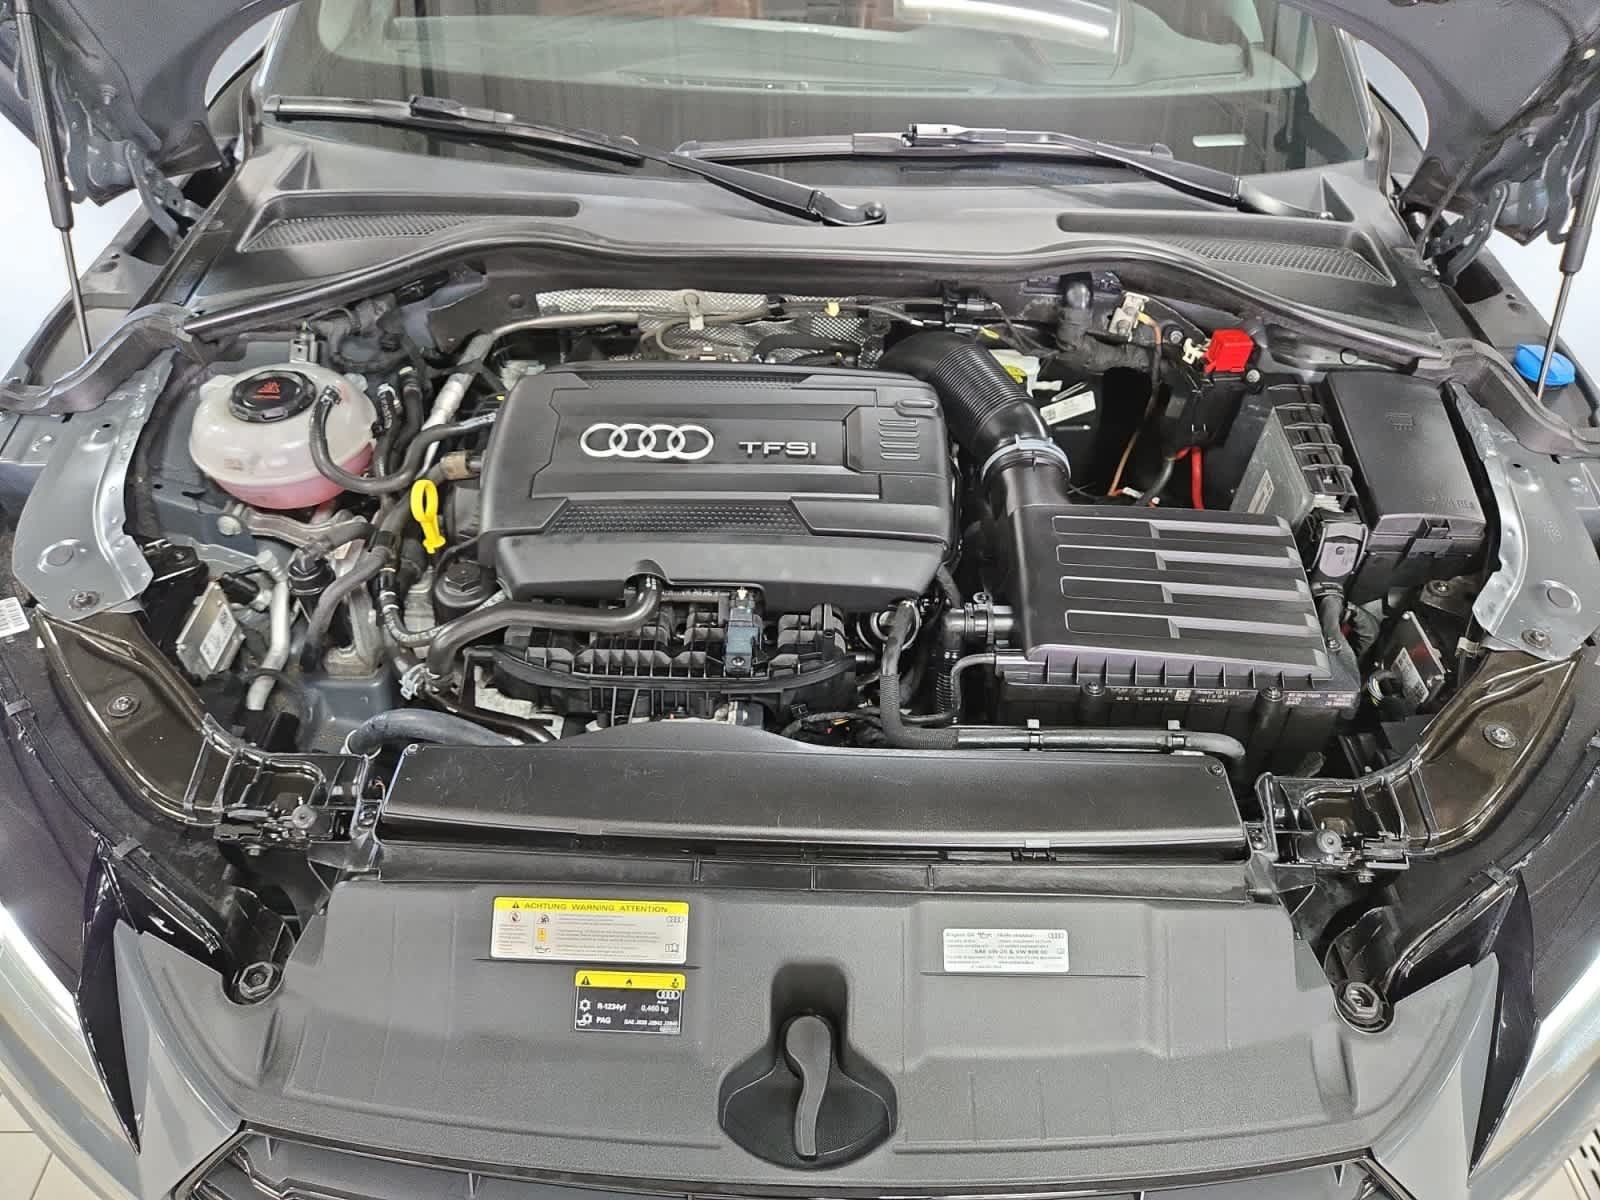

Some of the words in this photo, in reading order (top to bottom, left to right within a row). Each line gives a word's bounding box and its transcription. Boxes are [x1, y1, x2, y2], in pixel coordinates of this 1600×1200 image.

[738, 440, 818, 457] TFSI
[524, 902, 567, 911] ACHTUNG
[571, 903, 615, 912] WARNING
[619, 905, 668, 914] ATTENTION
[660, 1005, 669, 1014] kg
[596, 1016, 612, 1024] PAG
